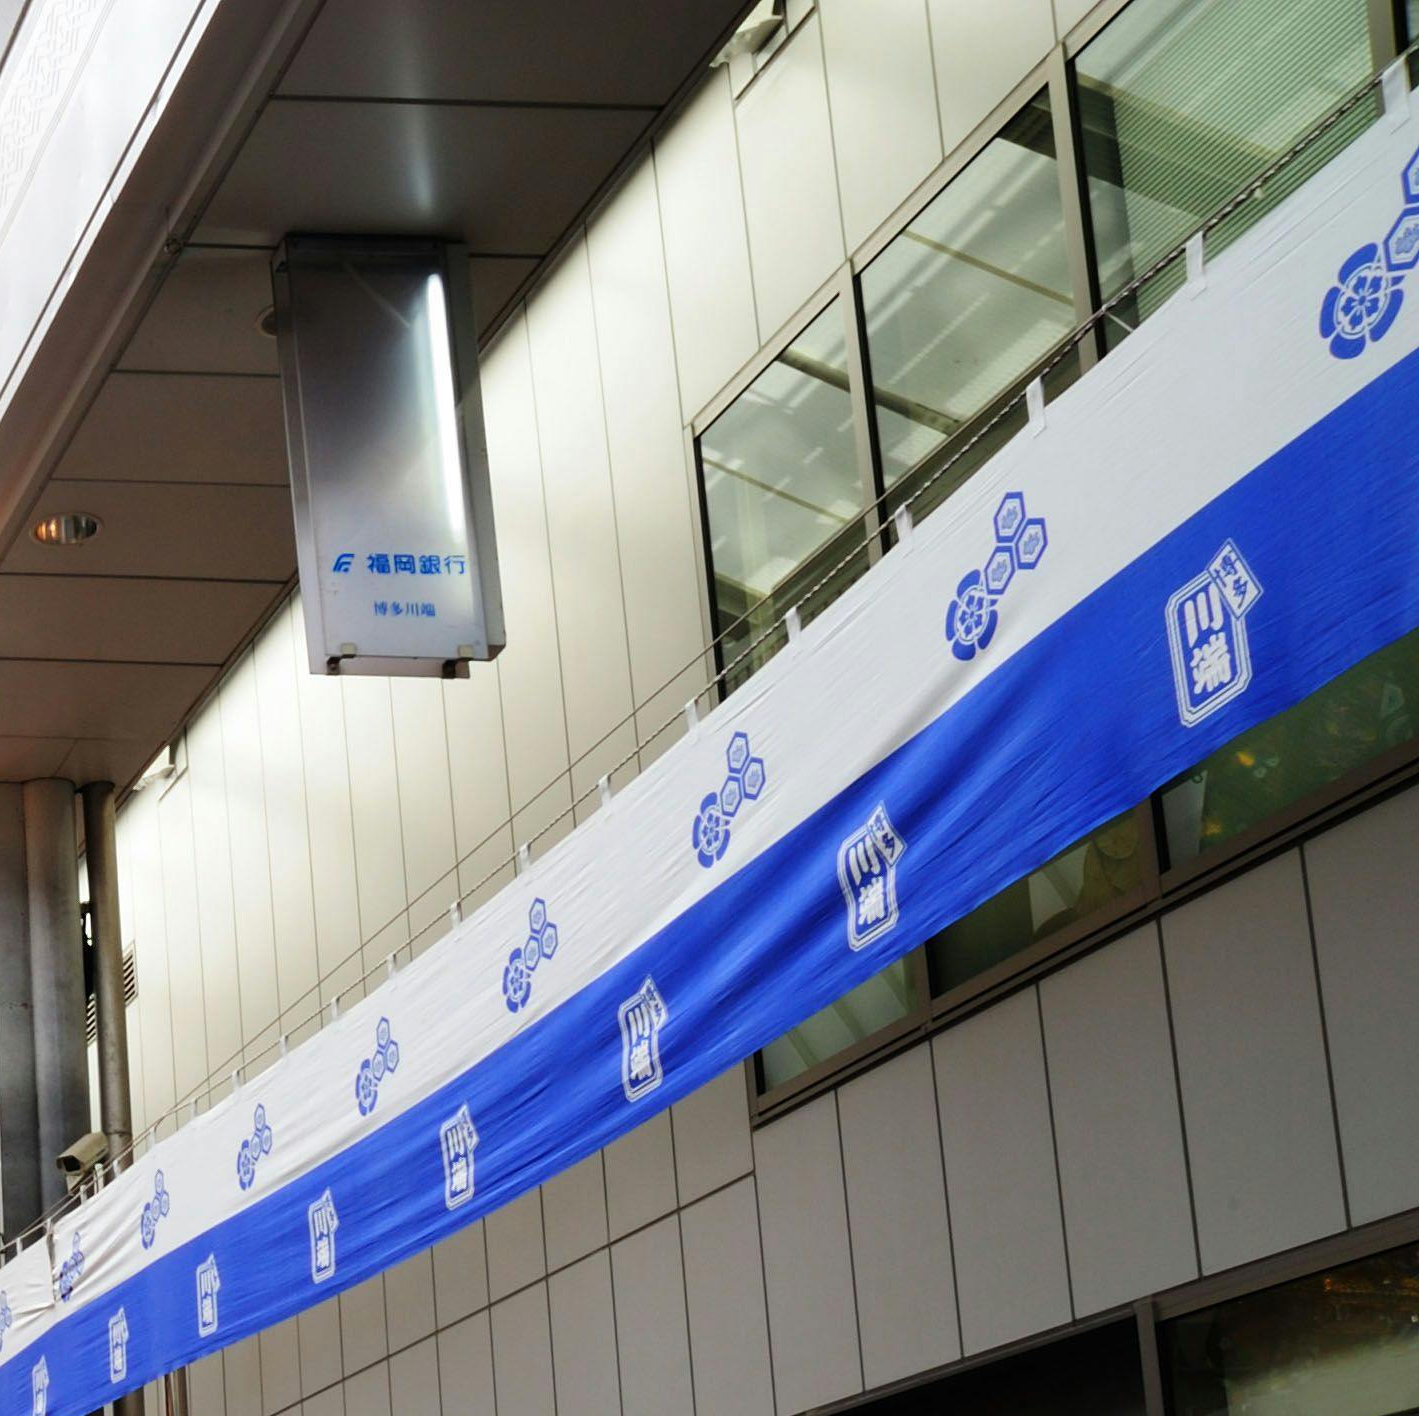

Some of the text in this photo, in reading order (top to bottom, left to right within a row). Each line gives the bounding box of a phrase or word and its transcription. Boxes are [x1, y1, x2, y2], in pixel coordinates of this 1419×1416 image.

[366, 553, 467, 576] 福岡銀行
[373, 602, 436, 617] 博多川端
